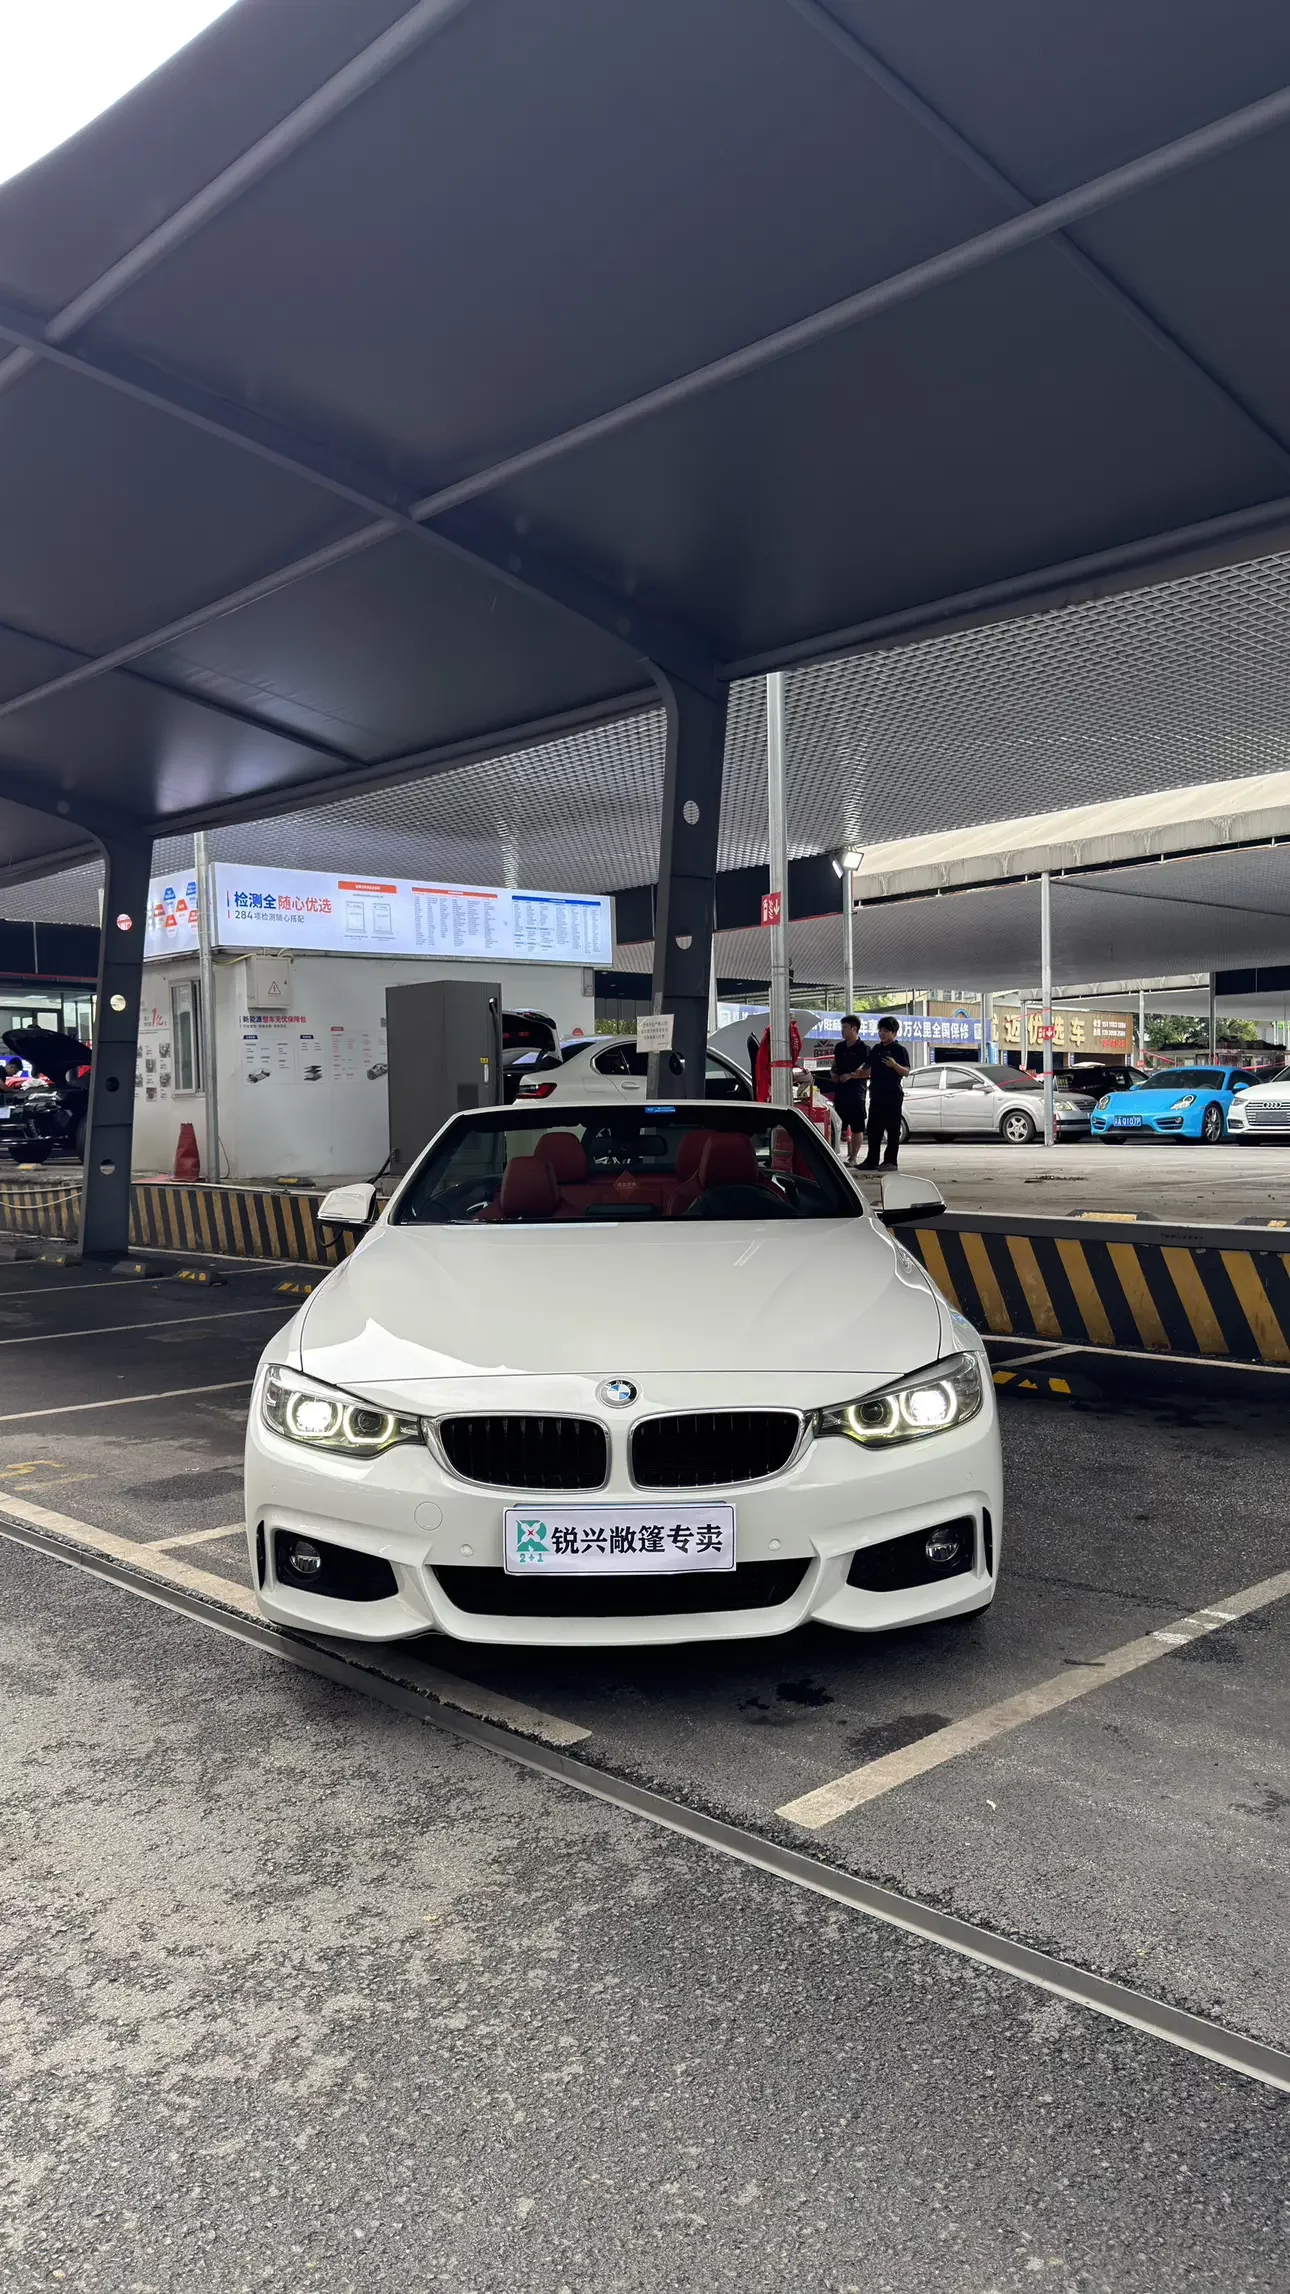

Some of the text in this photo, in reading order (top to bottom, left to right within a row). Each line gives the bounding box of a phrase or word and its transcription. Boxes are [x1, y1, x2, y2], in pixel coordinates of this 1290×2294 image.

[234, 891, 332, 913] 检测全随心优选
[235, 910, 305, 923] 284项检测随心搭配
[551, 1524, 723, 1555] 锐兴敞篷专卖
